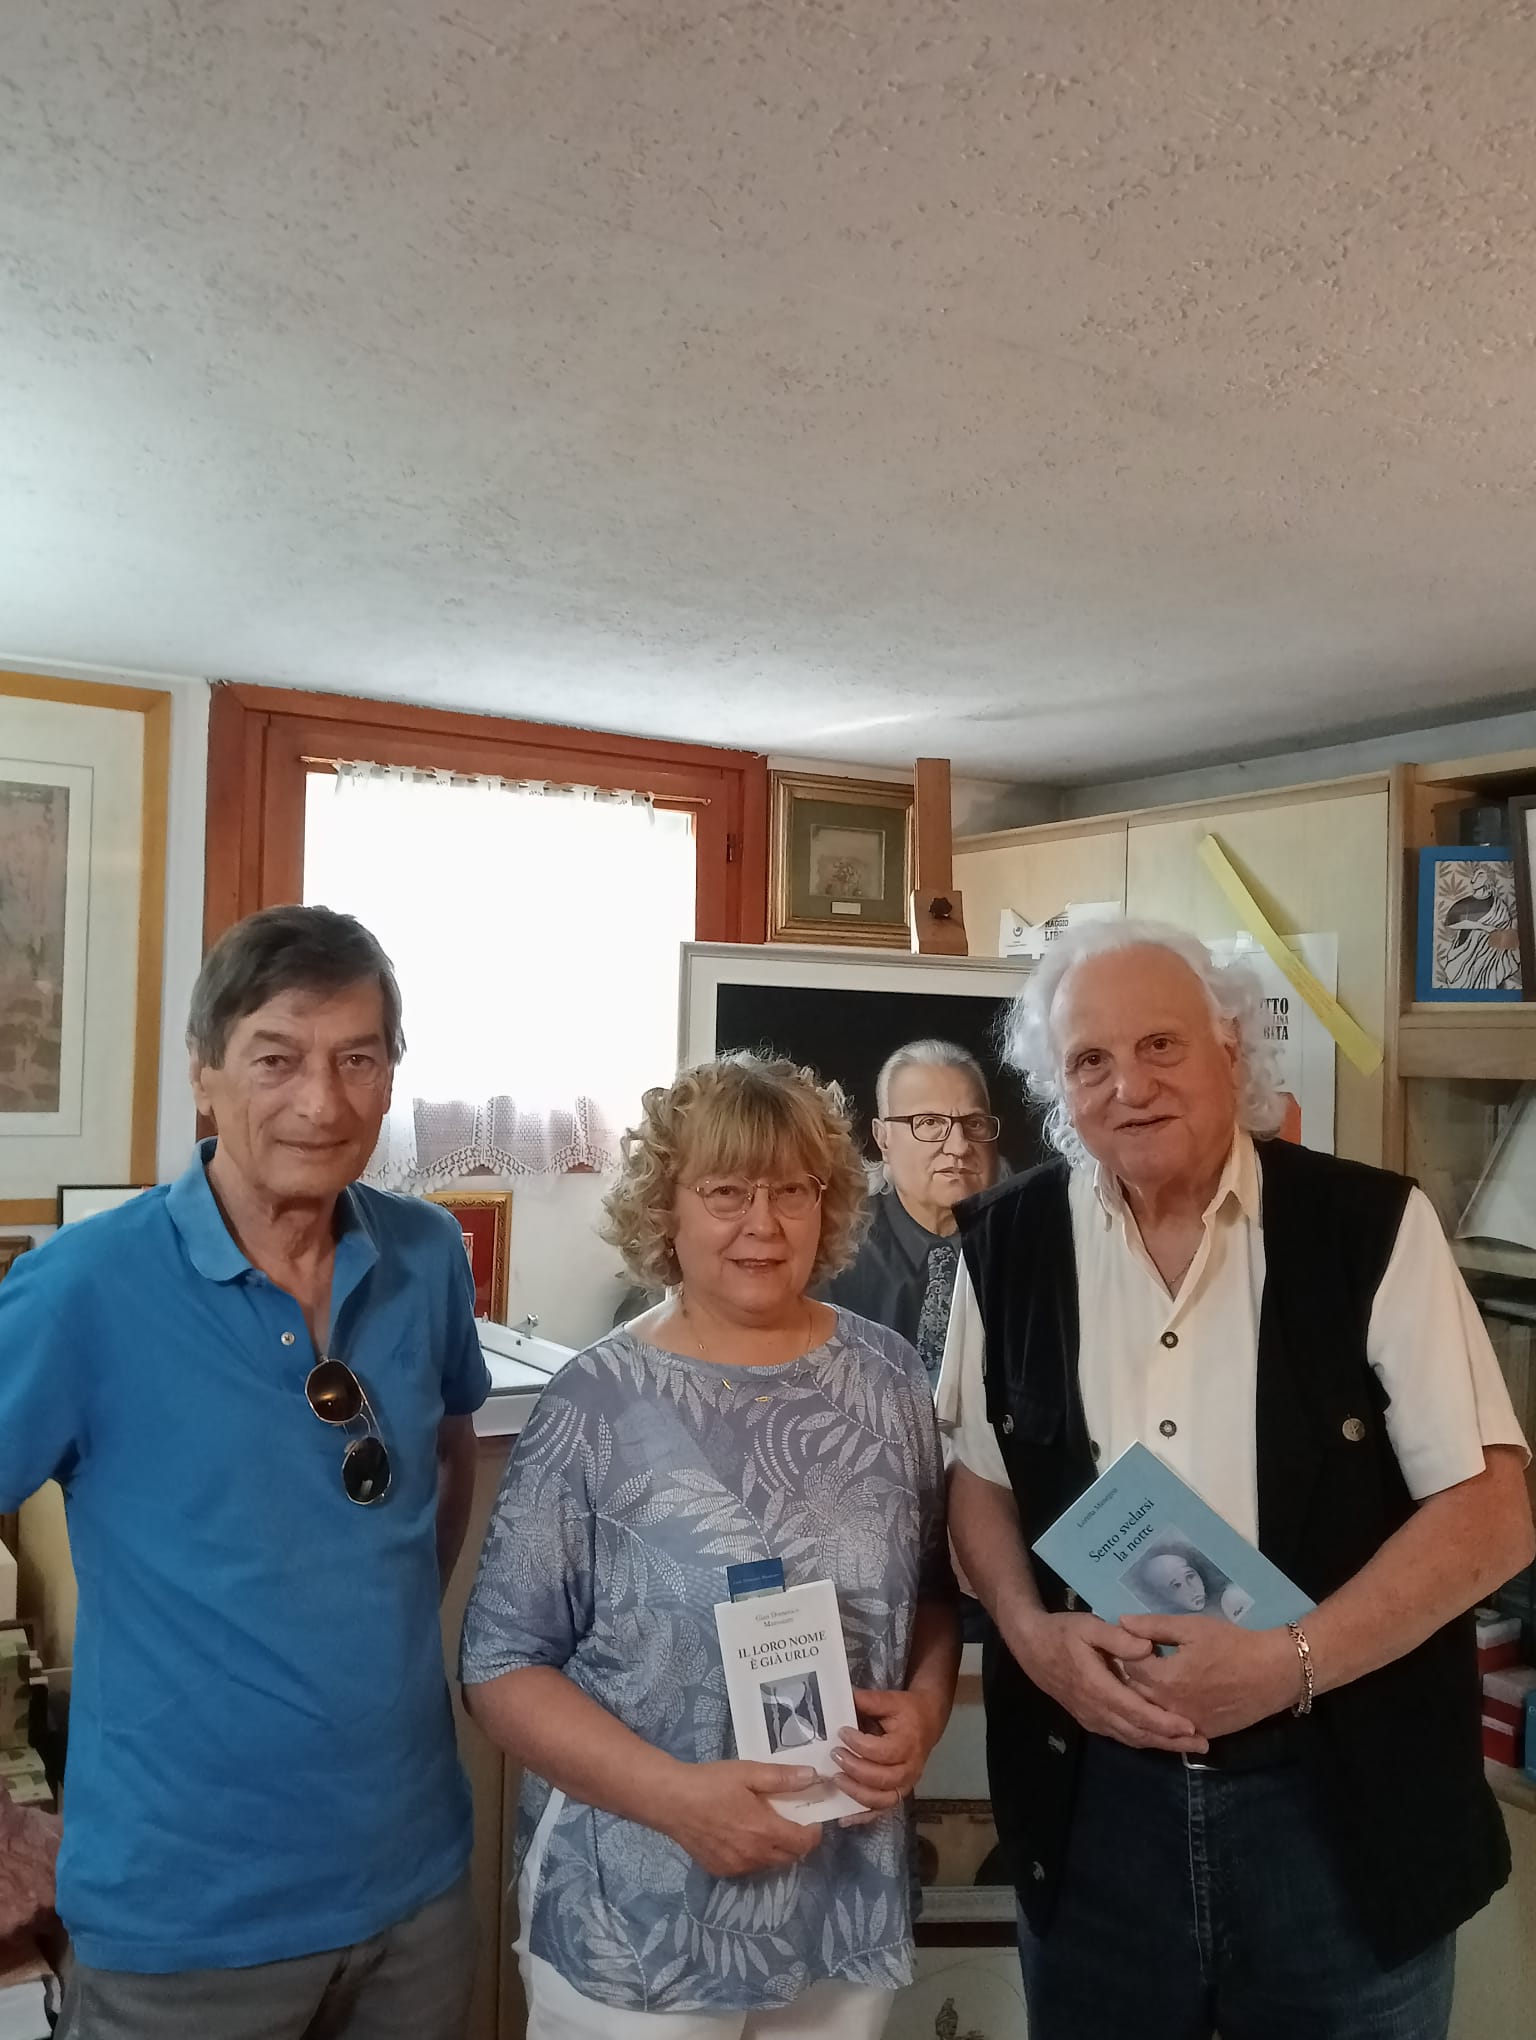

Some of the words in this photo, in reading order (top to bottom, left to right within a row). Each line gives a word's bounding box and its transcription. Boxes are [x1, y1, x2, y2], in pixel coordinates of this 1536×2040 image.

[1088, 1534, 1120, 1563] Sento
[1119, 1497, 1155, 1535] svelarsi
[1112, 1551, 1129, 1563] la
[1126, 1524, 1154, 1552] notte
[738, 1647, 751, 1659] IL
[752, 1639, 787, 1656] LORO
[789, 1630, 828, 1648] NOME
[750, 1656, 759, 1670] È
[760, 1652, 783, 1668] GIÀ
[784, 1646, 820, 1662] URLO
